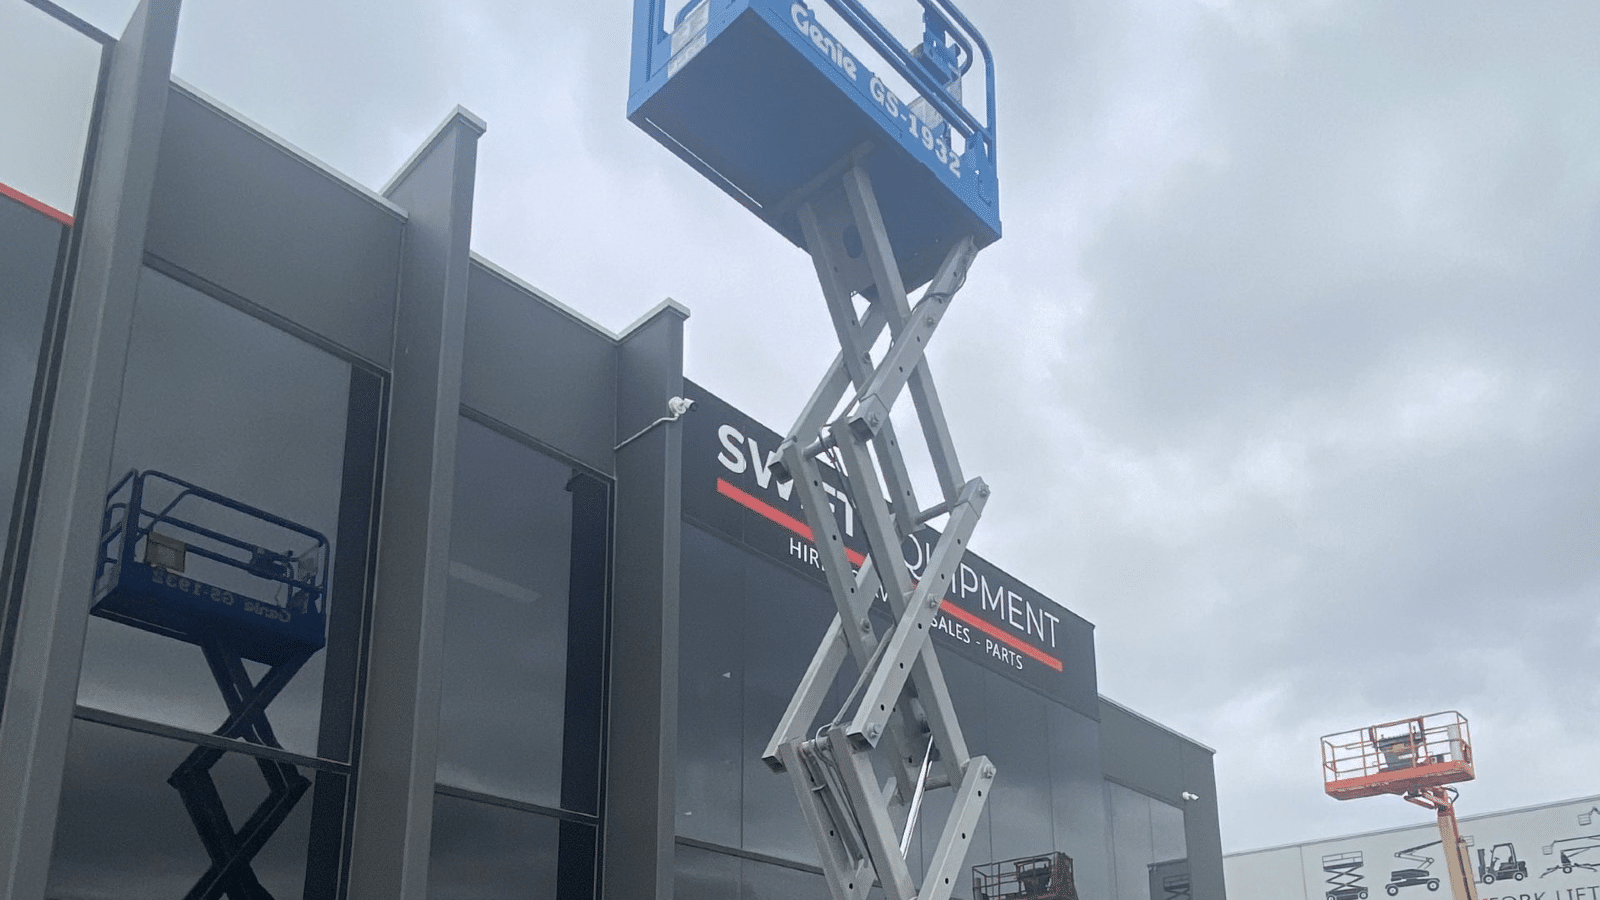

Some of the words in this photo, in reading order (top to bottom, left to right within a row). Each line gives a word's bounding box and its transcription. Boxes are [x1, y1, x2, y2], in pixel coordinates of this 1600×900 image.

[791, 3, 857, 81] Genie
[869, 76, 961, 179] GS-1932
[717, 424, 855, 537] SWT
[903, 533, 1060, 648] QIPMENT
[789, 537, 825, 571] HIR
[986, 638, 1023, 670] PARTS
